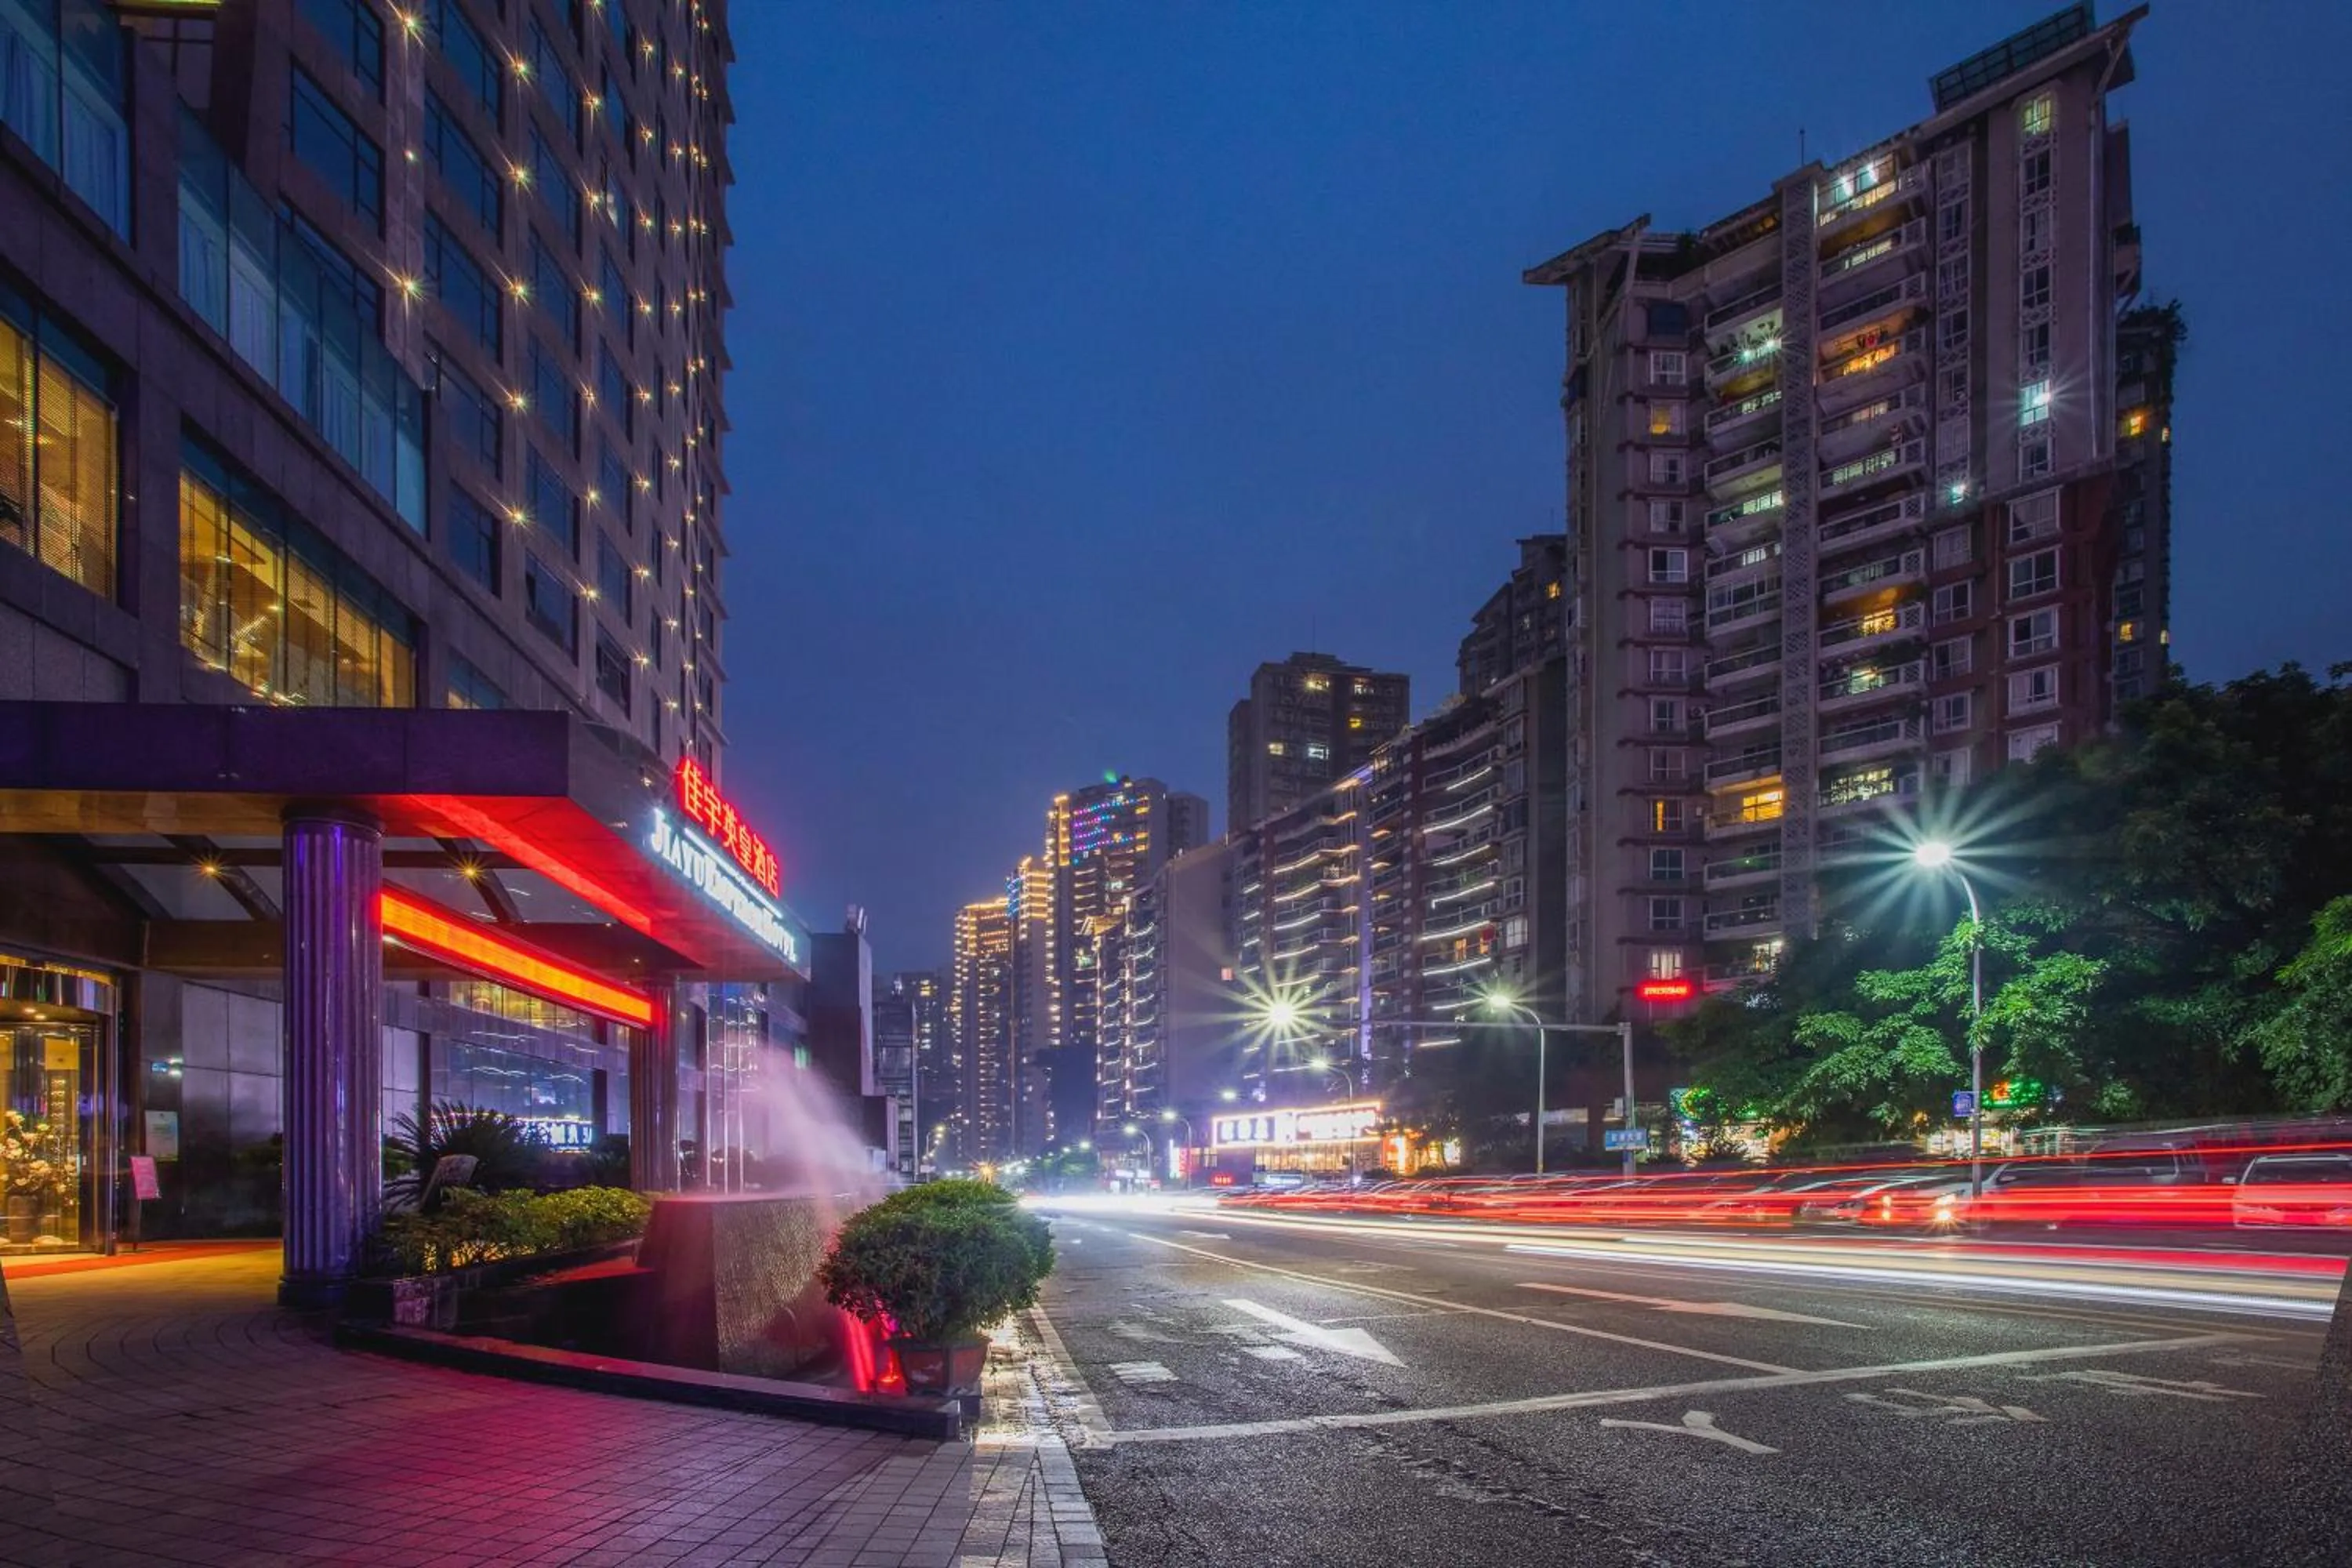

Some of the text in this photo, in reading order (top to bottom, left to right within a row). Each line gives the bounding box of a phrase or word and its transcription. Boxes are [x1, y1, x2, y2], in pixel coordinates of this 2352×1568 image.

[682, 758, 779, 899] 佳宇英皇酒店
